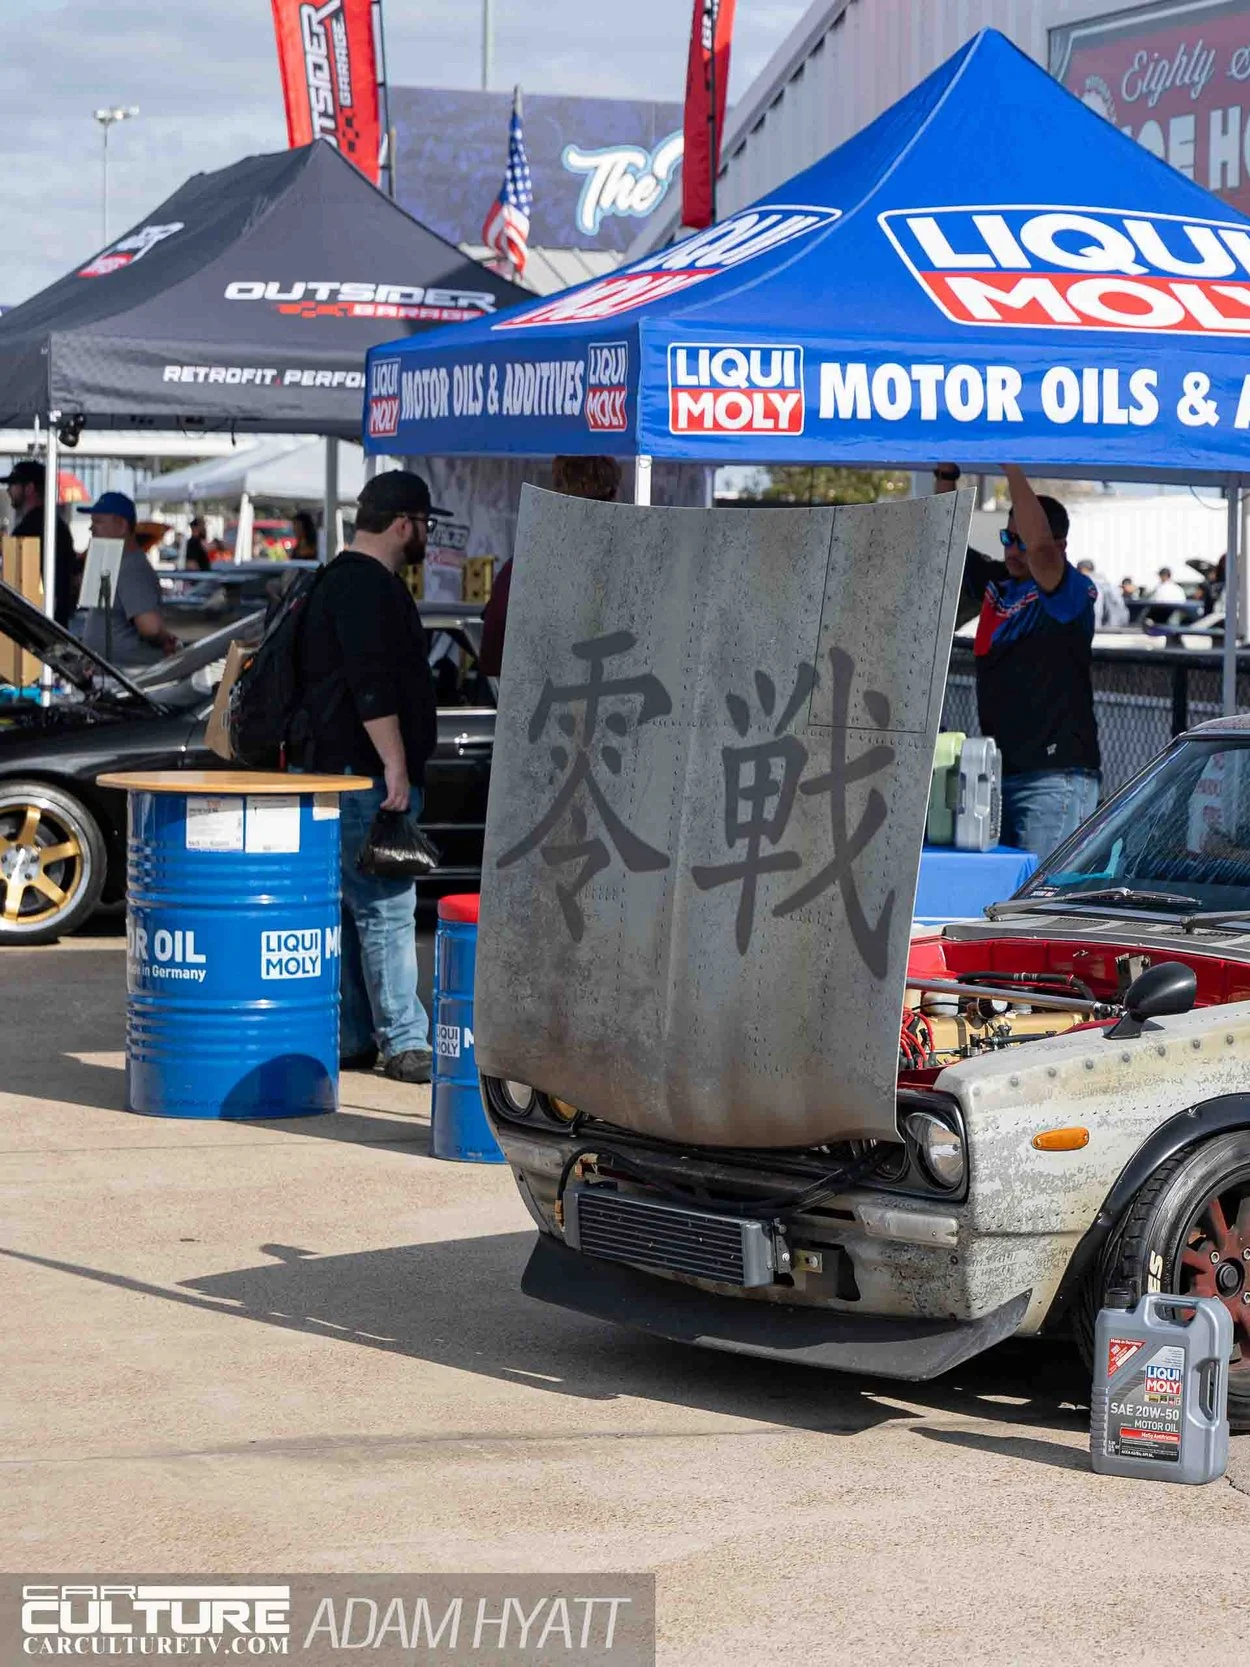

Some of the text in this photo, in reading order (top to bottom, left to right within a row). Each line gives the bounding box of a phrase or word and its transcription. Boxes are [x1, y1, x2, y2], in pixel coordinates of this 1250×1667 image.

[301, 0, 340, 149] TSIDER
[1120, 38, 1217, 107] Eighty
[566, 149, 662, 231] The
[223, 280, 499, 313] OUTSIDER
[162, 365, 278, 386] RETROFIT
[371, 362, 399, 396] LIQUI
[588, 347, 627, 386] LIQUI
[674, 348, 796, 391] LIQUI
[401, 360, 585, 421] MOTOR OILS & ADDITIVES
[818, 361, 1025, 423] MOTOR
[1040, 364, 1158, 427] OILS
[1176, 371, 1221, 428] &
[370, 399, 399, 433] MOLY
[586, 389, 626, 427] MOLY
[676, 391, 801, 431] MOLY
[154, 929, 207, 964] OIL
[265, 932, 319, 952] LIQUI
[151, 964, 207, 983] Germany
[265, 955, 319, 977] MOLY
[438, 1041, 459, 1055] OLY
[1146, 1380, 1181, 1394] MOLY
[1147, 1366, 1180, 1381] LIQUI
[1110, 1402, 1180, 1421] SAE 20W-50
[1134, 1420, 1164, 1431] MOTOR
[1164, 1423, 1179, 1433] OIL
